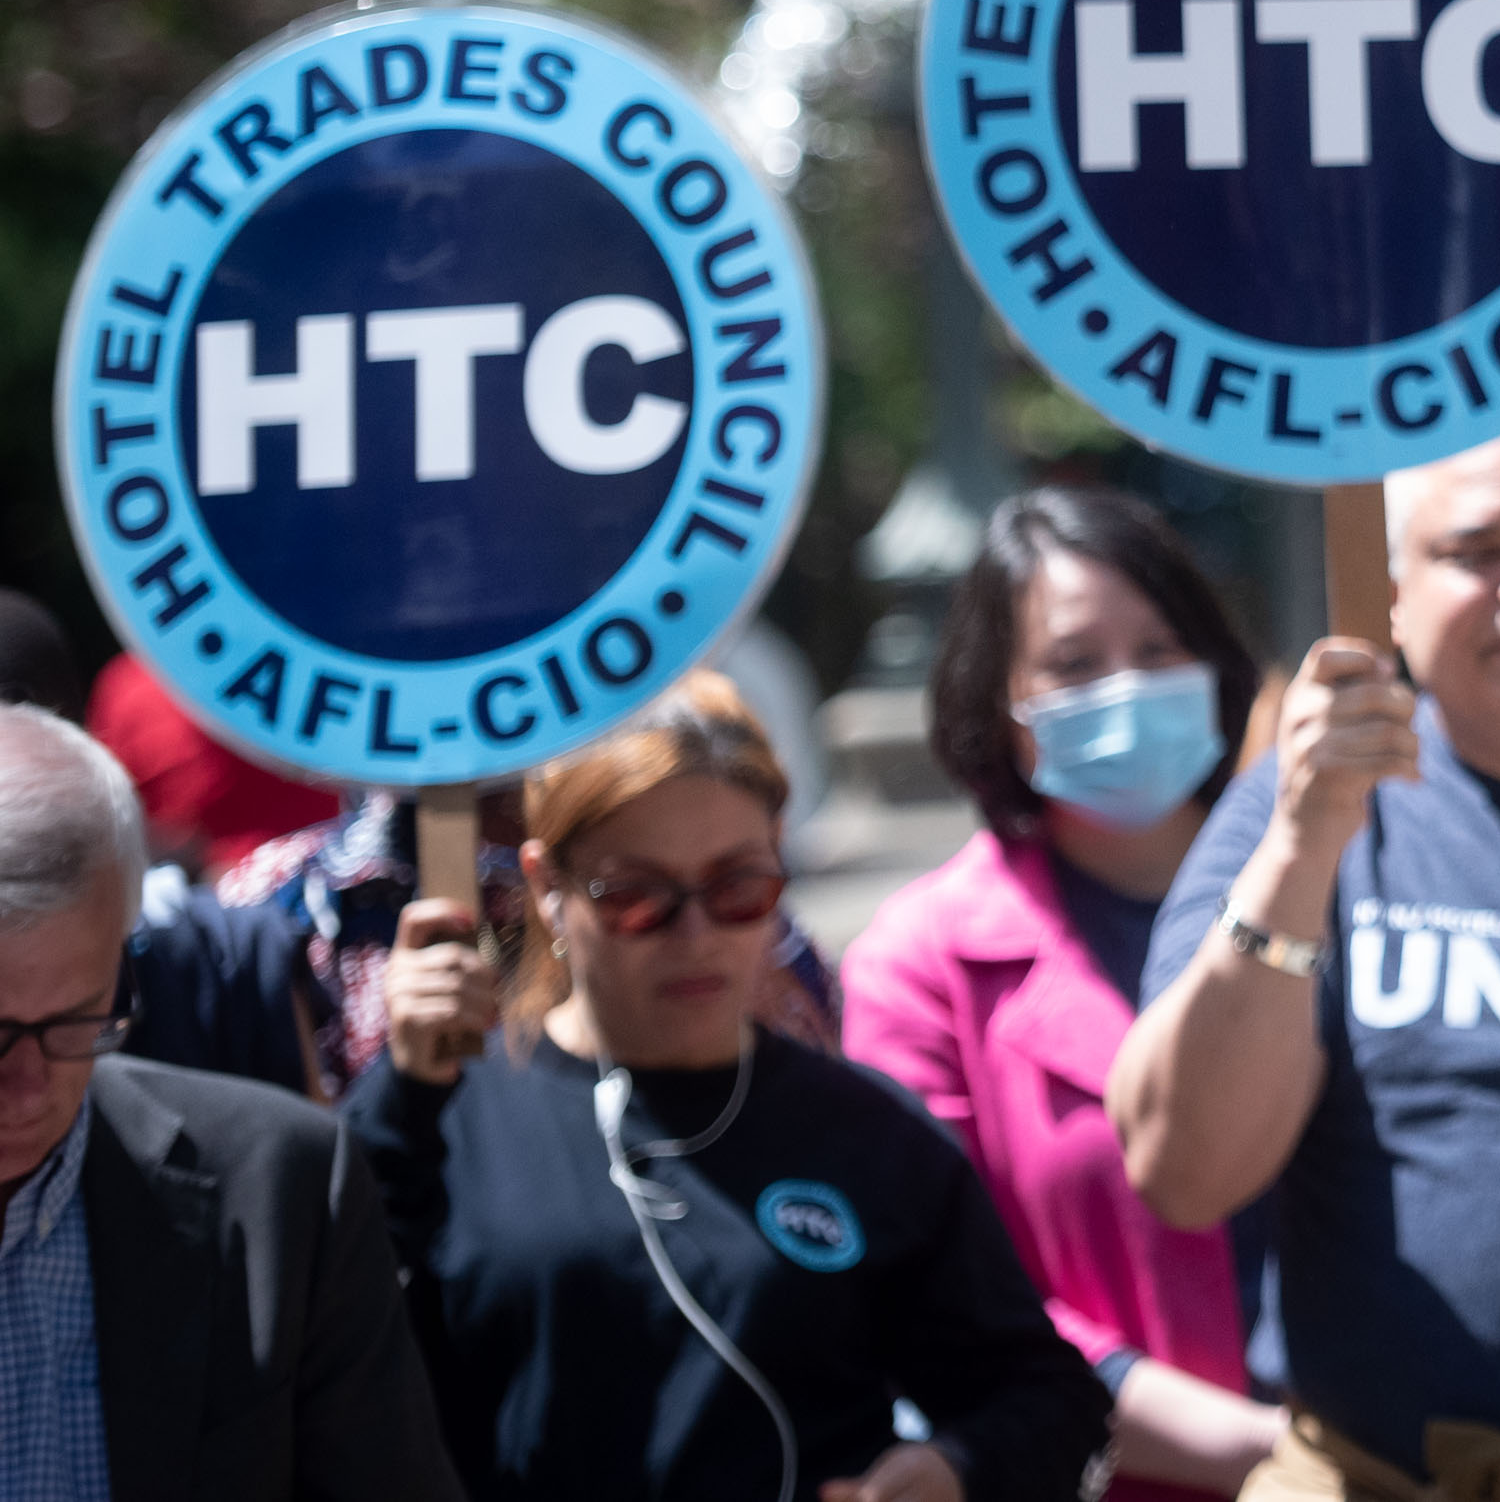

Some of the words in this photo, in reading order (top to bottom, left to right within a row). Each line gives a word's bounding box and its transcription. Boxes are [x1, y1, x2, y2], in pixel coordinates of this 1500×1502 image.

[93, 269, 212, 629] HOTEL
[159, 39, 575, 219] TRADES
[607, 102, 787, 558] COUNCIL
[199, 295, 688, 496] HTC
[221, 615, 657, 756] AFL-CIO
